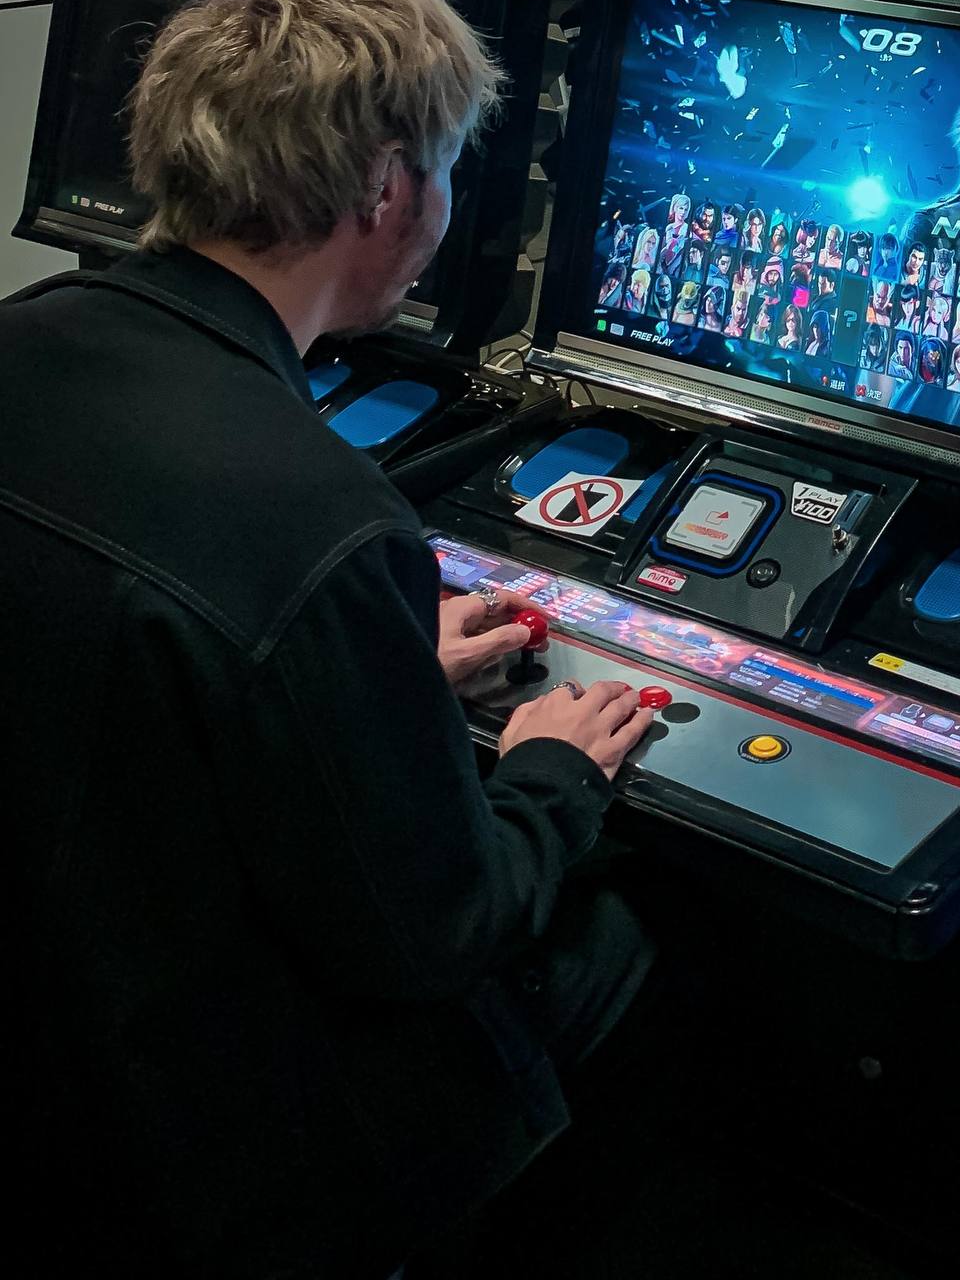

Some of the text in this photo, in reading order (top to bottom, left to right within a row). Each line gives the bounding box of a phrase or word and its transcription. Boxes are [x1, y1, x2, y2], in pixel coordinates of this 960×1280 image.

[630, 329, 674, 347] FREE PLAY
[808, 417, 840, 431] namco
[808, 490, 838, 504] PLAY
[794, 499, 835, 520] ¥100
